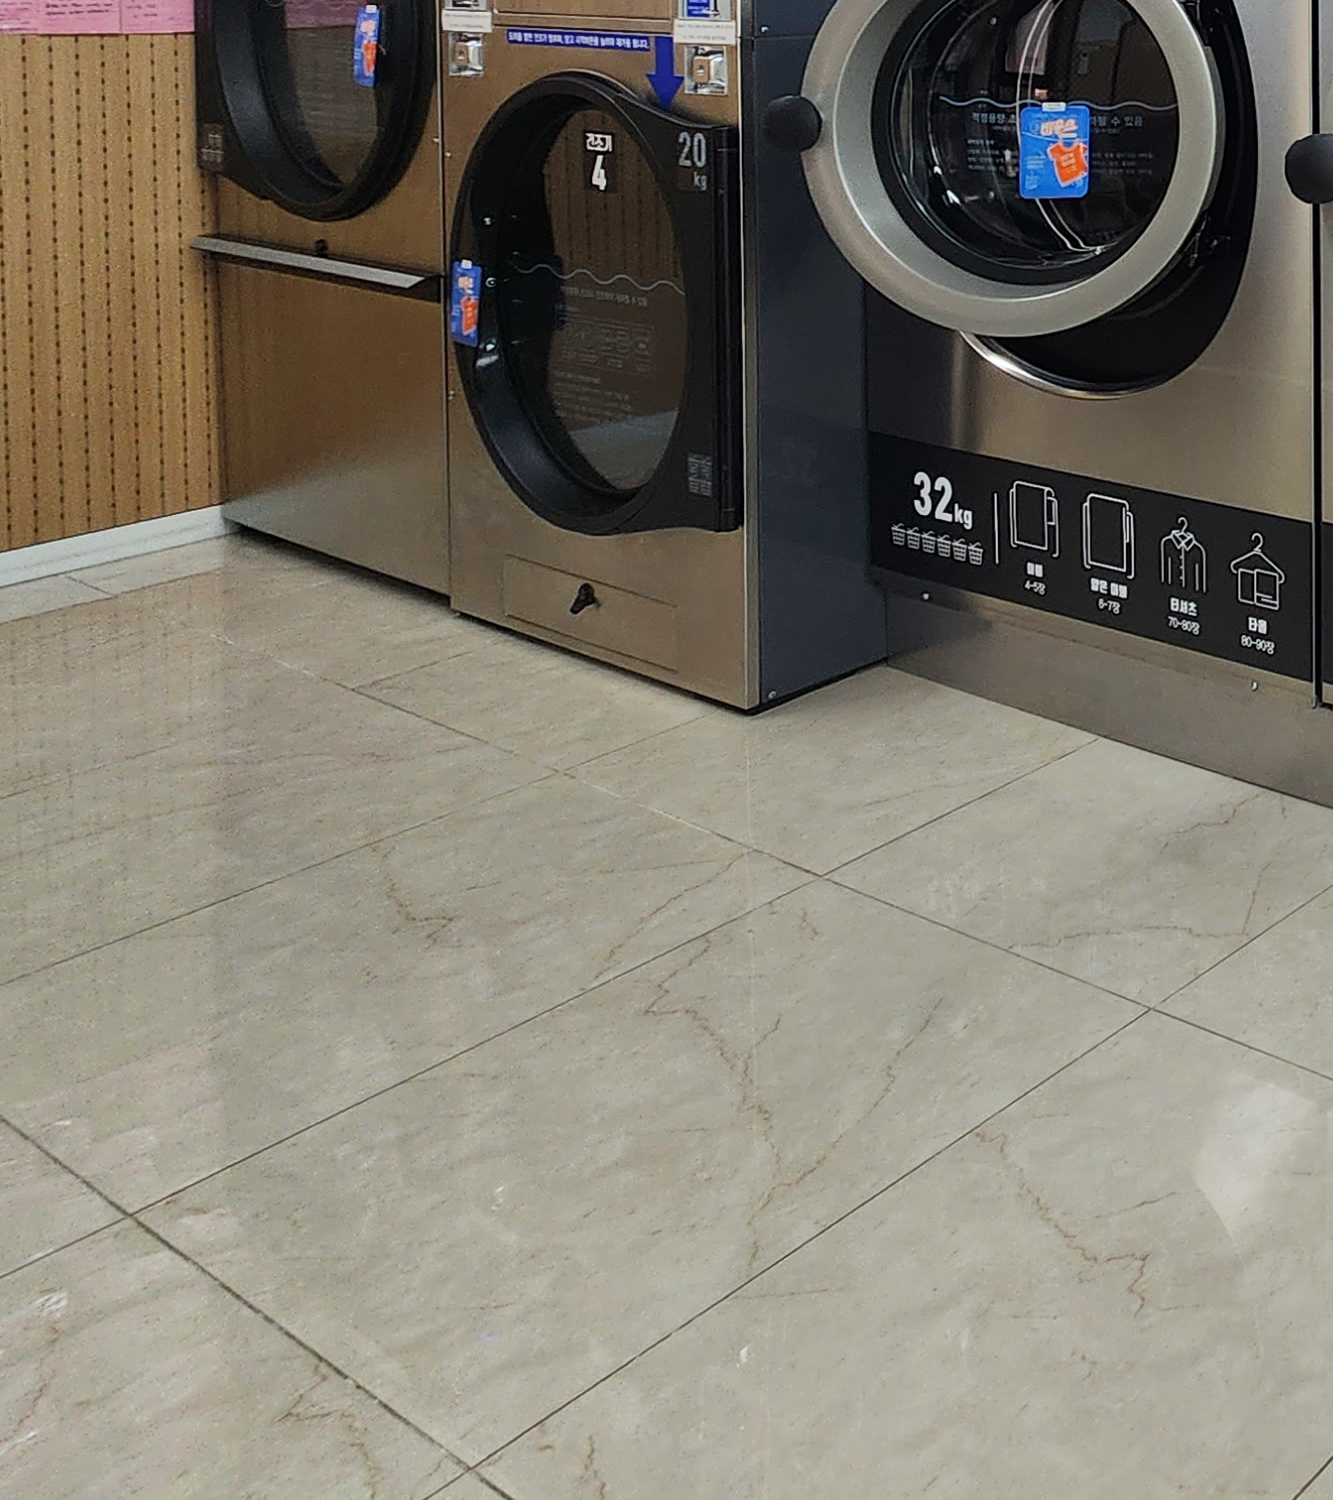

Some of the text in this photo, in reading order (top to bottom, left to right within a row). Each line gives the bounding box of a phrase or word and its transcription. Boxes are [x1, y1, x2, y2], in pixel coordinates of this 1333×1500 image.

[678, 132, 708, 168] 20
[591, 154, 607, 191] 4
[693, 174, 708, 191] kg
[913, 471, 973, 531] 32kg
